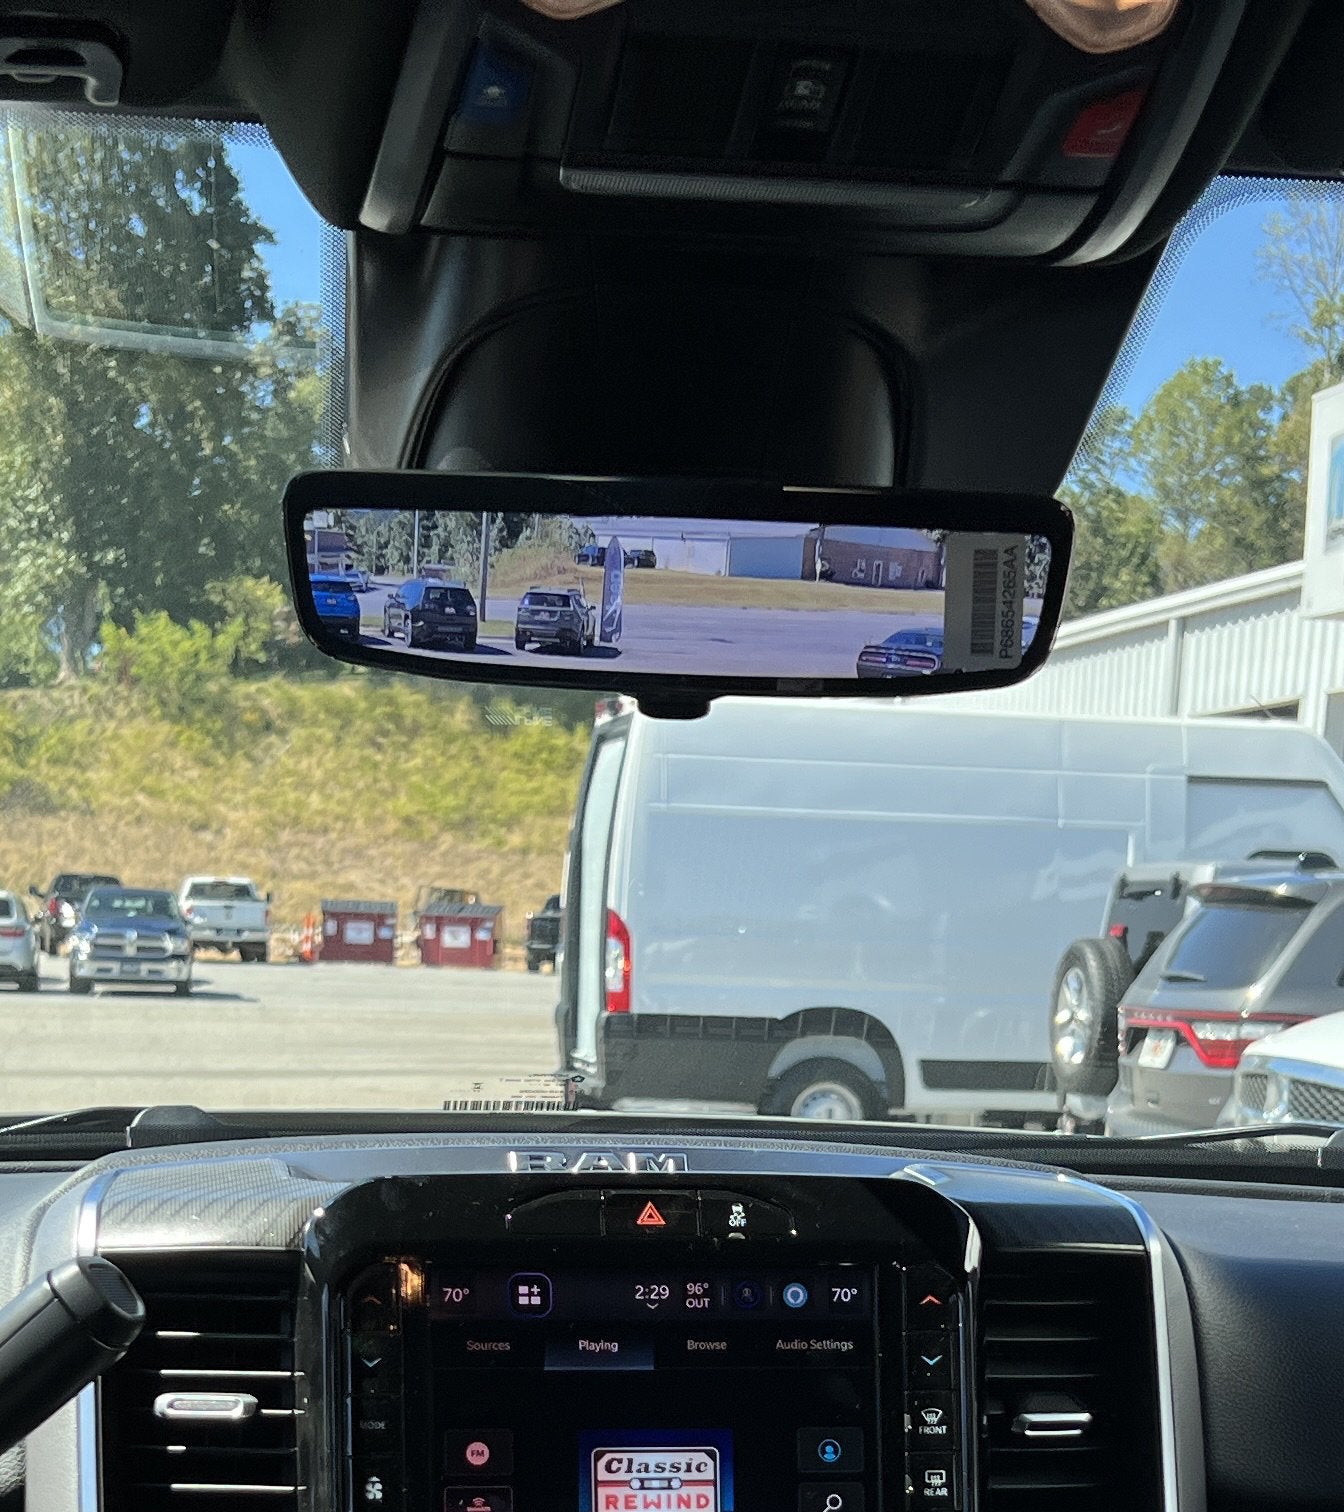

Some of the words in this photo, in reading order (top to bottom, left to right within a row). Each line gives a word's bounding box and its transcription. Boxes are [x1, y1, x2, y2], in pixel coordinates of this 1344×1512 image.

[508, 1150, 690, 1174] RAM
[728, 1214, 747, 1227] OFF
[635, 1284, 670, 1300] 2:29
[686, 1297, 711, 1309] OUT
[466, 1340, 511, 1352] Sources
[578, 1339, 619, 1354] Playing
[687, 1339, 728, 1351] Browse
[776, 1339, 808, 1351] Audio
[809, 1339, 854, 1353] Settings
[918, 1425, 948, 1435] FRONT
[470, 1449, 485, 1458] FM
[604, 1457, 709, 1474] Classic
[923, 1487, 948, 1497] REAR
[605, 1493, 711, 1510] REWIND
